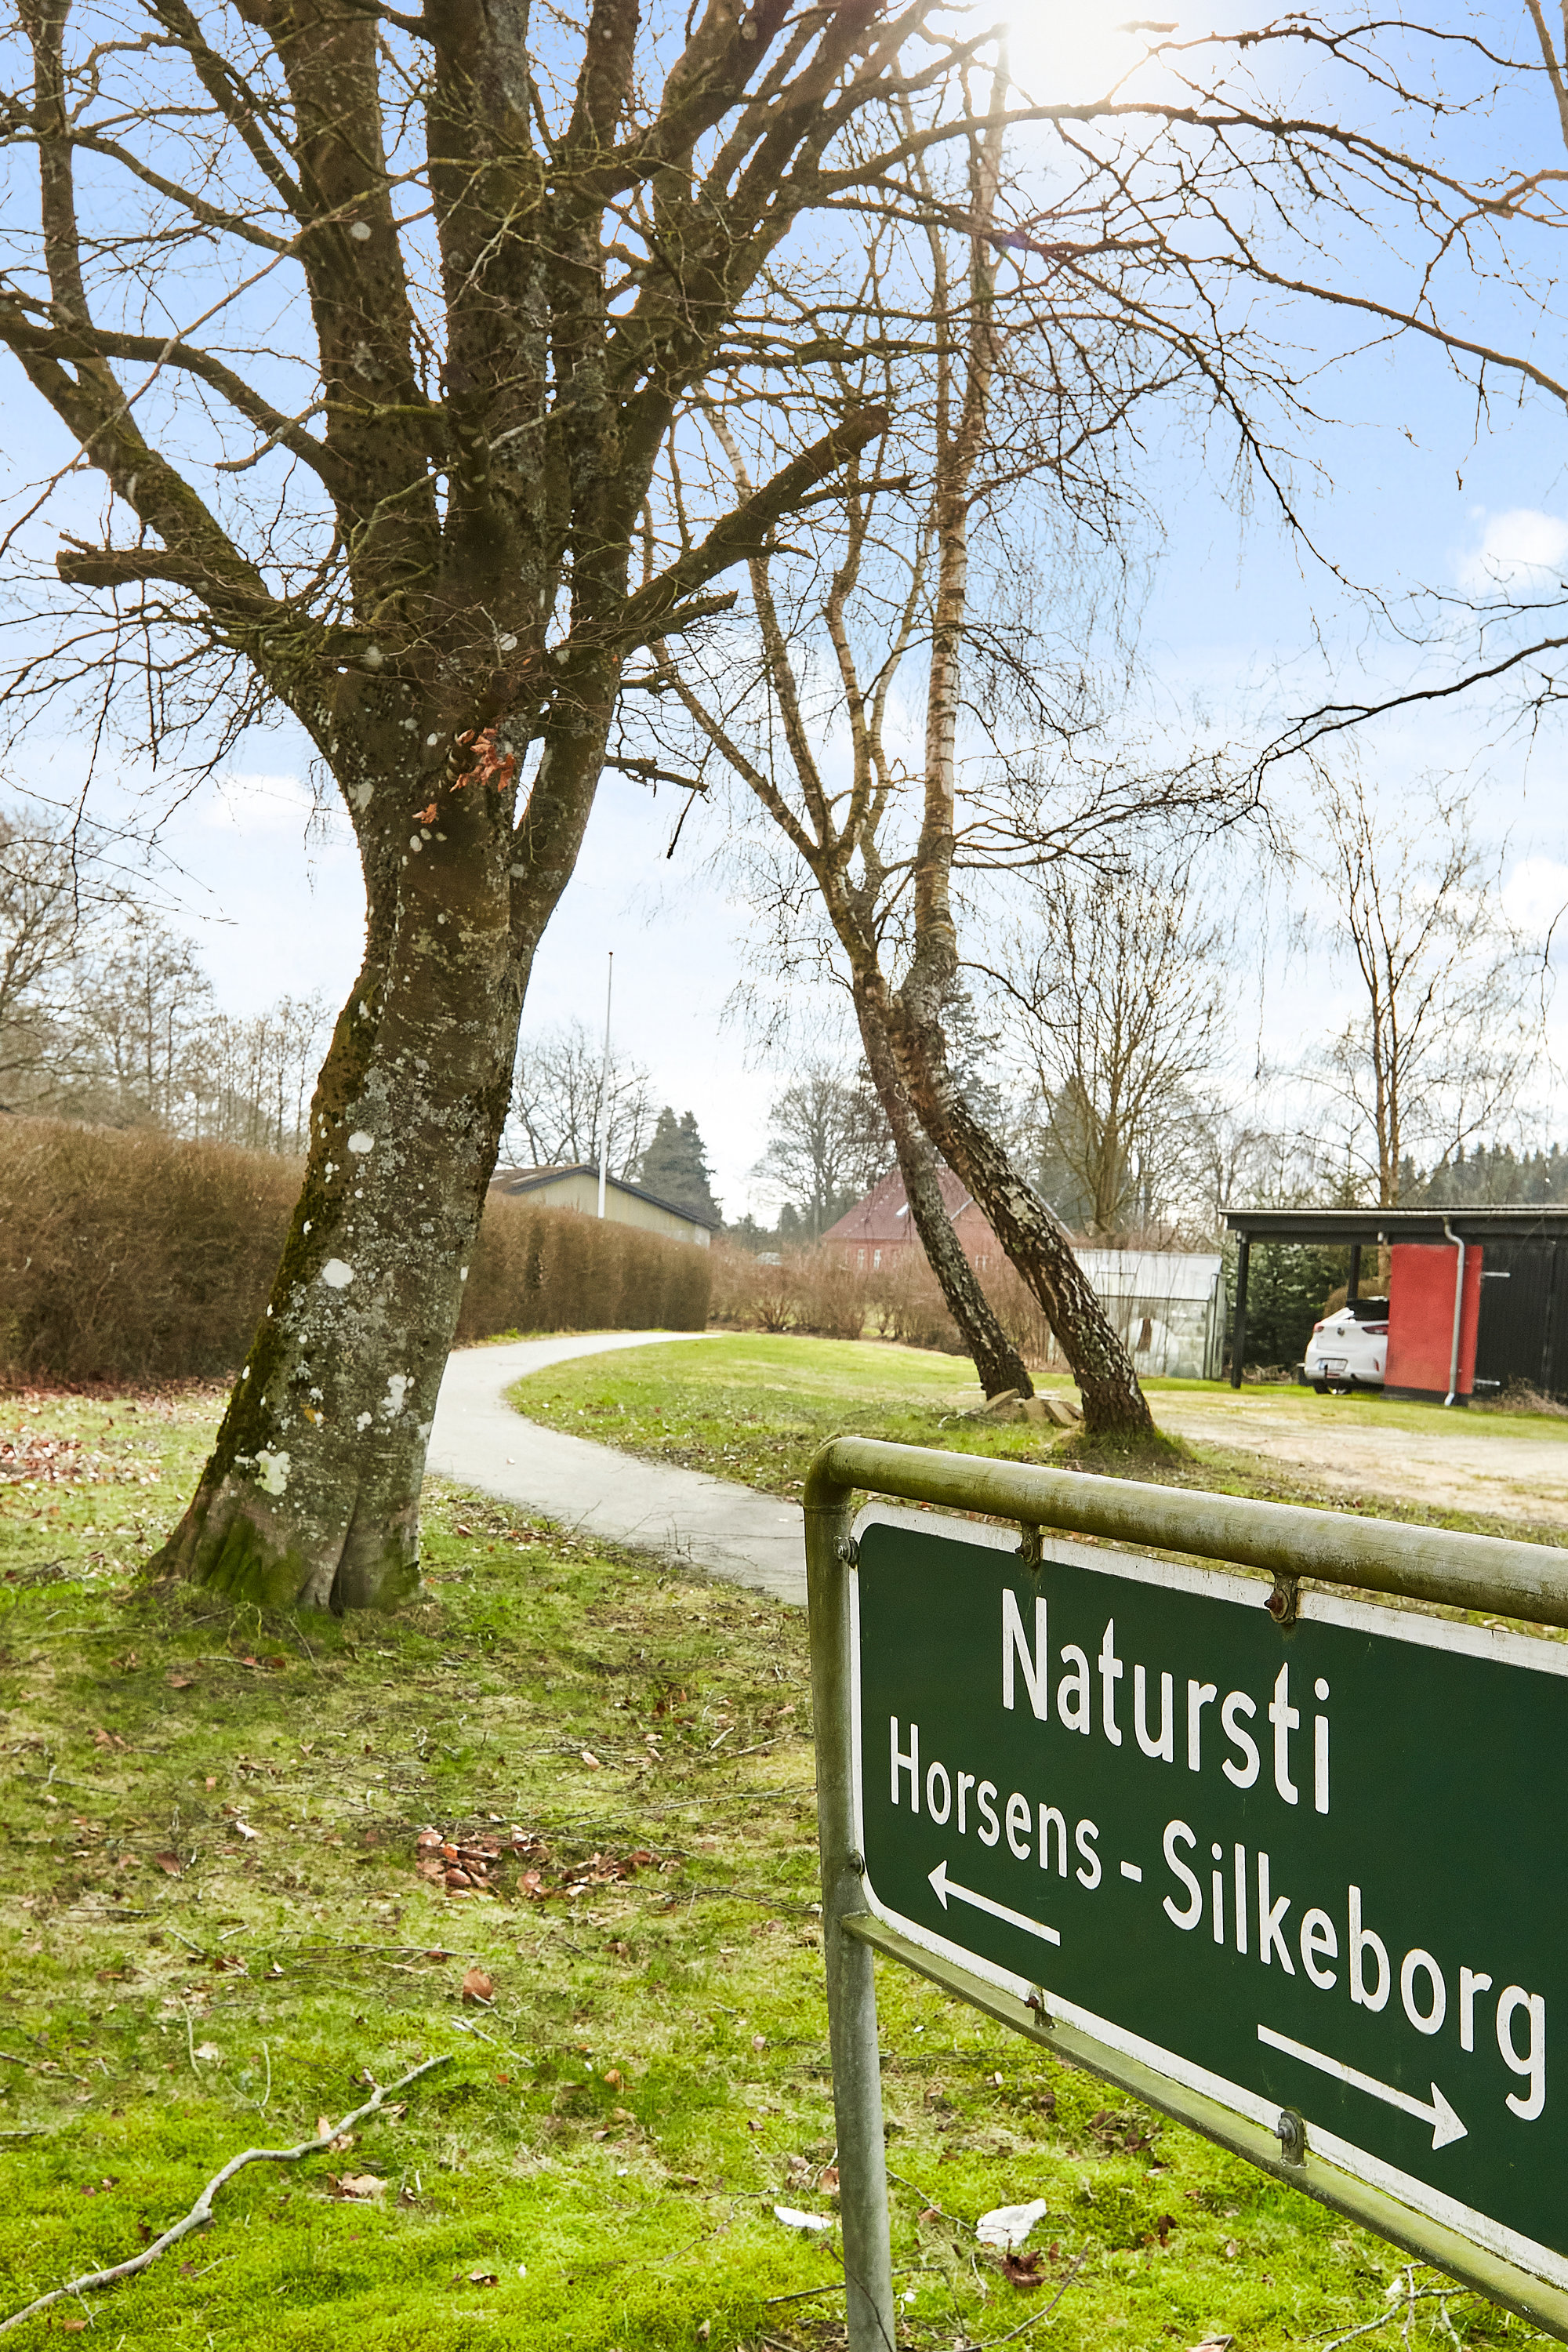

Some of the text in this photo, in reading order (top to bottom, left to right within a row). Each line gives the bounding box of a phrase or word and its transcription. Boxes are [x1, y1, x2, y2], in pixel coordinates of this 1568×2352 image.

[1001, 1587, 1330, 1816] Natursti
[889, 1715, 1102, 1891] Horsens
[1162, 1819, 1547, 2122] Silkeborg
